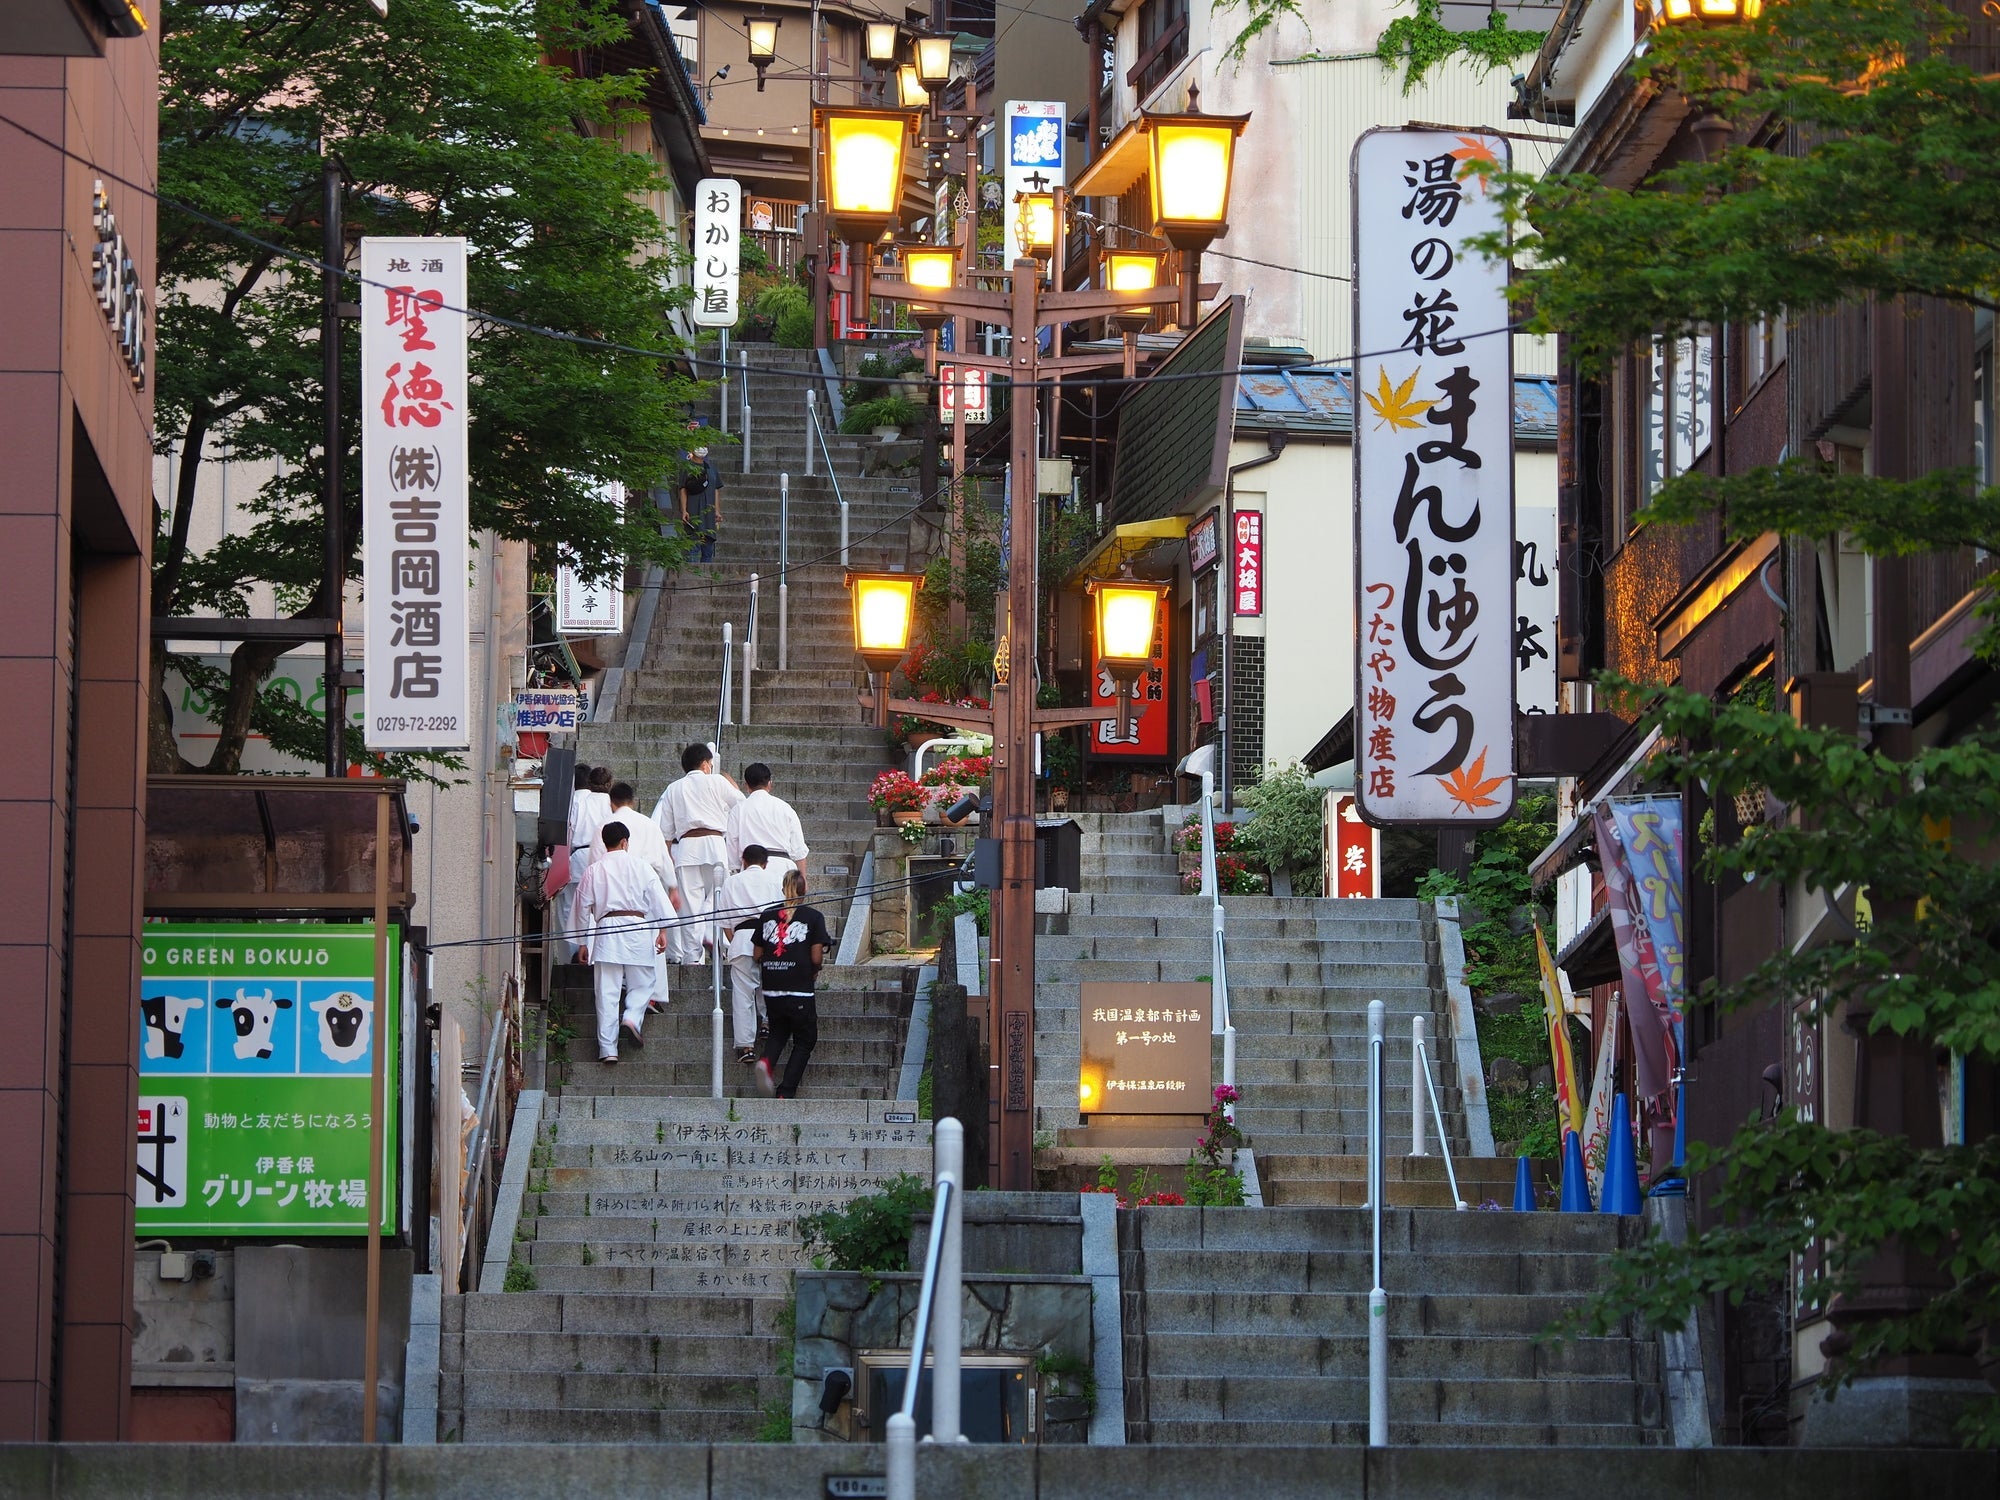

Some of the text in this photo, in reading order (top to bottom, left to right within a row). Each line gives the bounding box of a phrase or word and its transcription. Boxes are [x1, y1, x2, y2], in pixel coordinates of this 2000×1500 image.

[1016, 103, 1056, 115] 地酒
[703, 189, 730, 314] おかし屋
[387, 258, 444, 273] 地酒
[381, 285, 454, 428] 聖徳
[1366, 583, 1397, 799] つたや物産店
[376, 716, 458, 732] 0279-72-2292
[517, 710, 576, 727] 推奨の店
[166, 948, 235, 965] GREEN
[1092, 1008, 1201, 1022] 我国温泉都市計画
[1116, 1031, 1177, 1046] 第一号の地
[1106, 1080, 1187, 1091] 伊香保温泉石段街
[203, 1113, 372, 1129] 動物と友だちになろう
[255, 1156, 315, 1174] 伊香保
[202, 1174, 367, 1208] グリーン牧場
